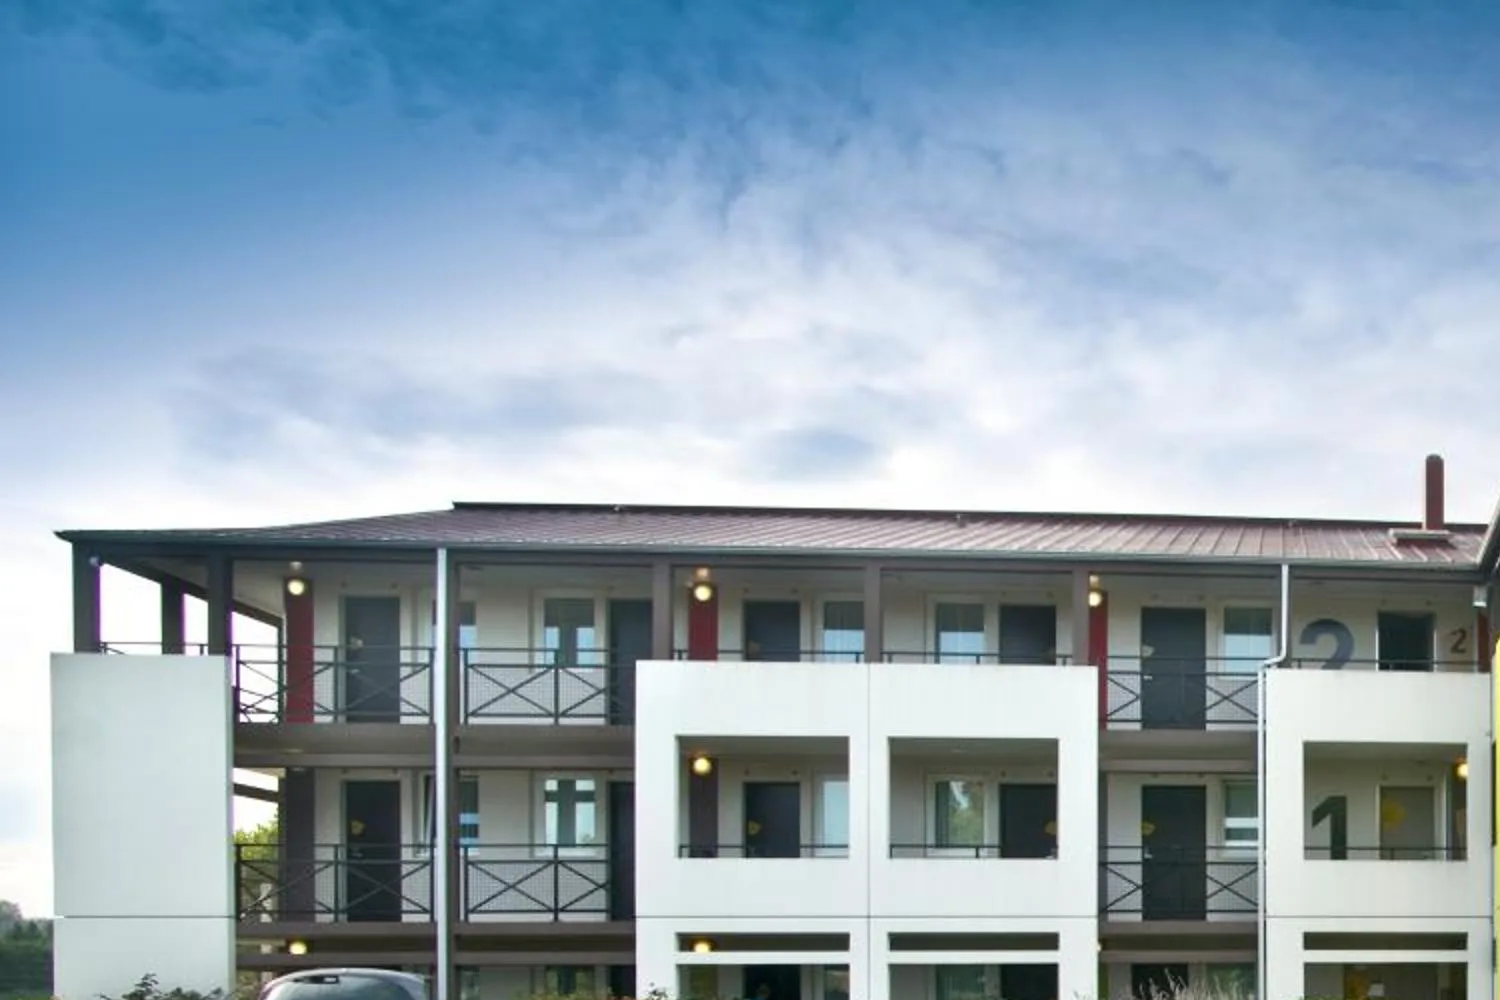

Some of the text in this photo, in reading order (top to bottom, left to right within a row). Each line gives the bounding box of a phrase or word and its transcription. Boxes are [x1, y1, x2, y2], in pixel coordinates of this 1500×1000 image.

[1300, 618, 1354, 670] 2
[1451, 628, 1468, 654] 2
[1312, 795, 1347, 860] 1
